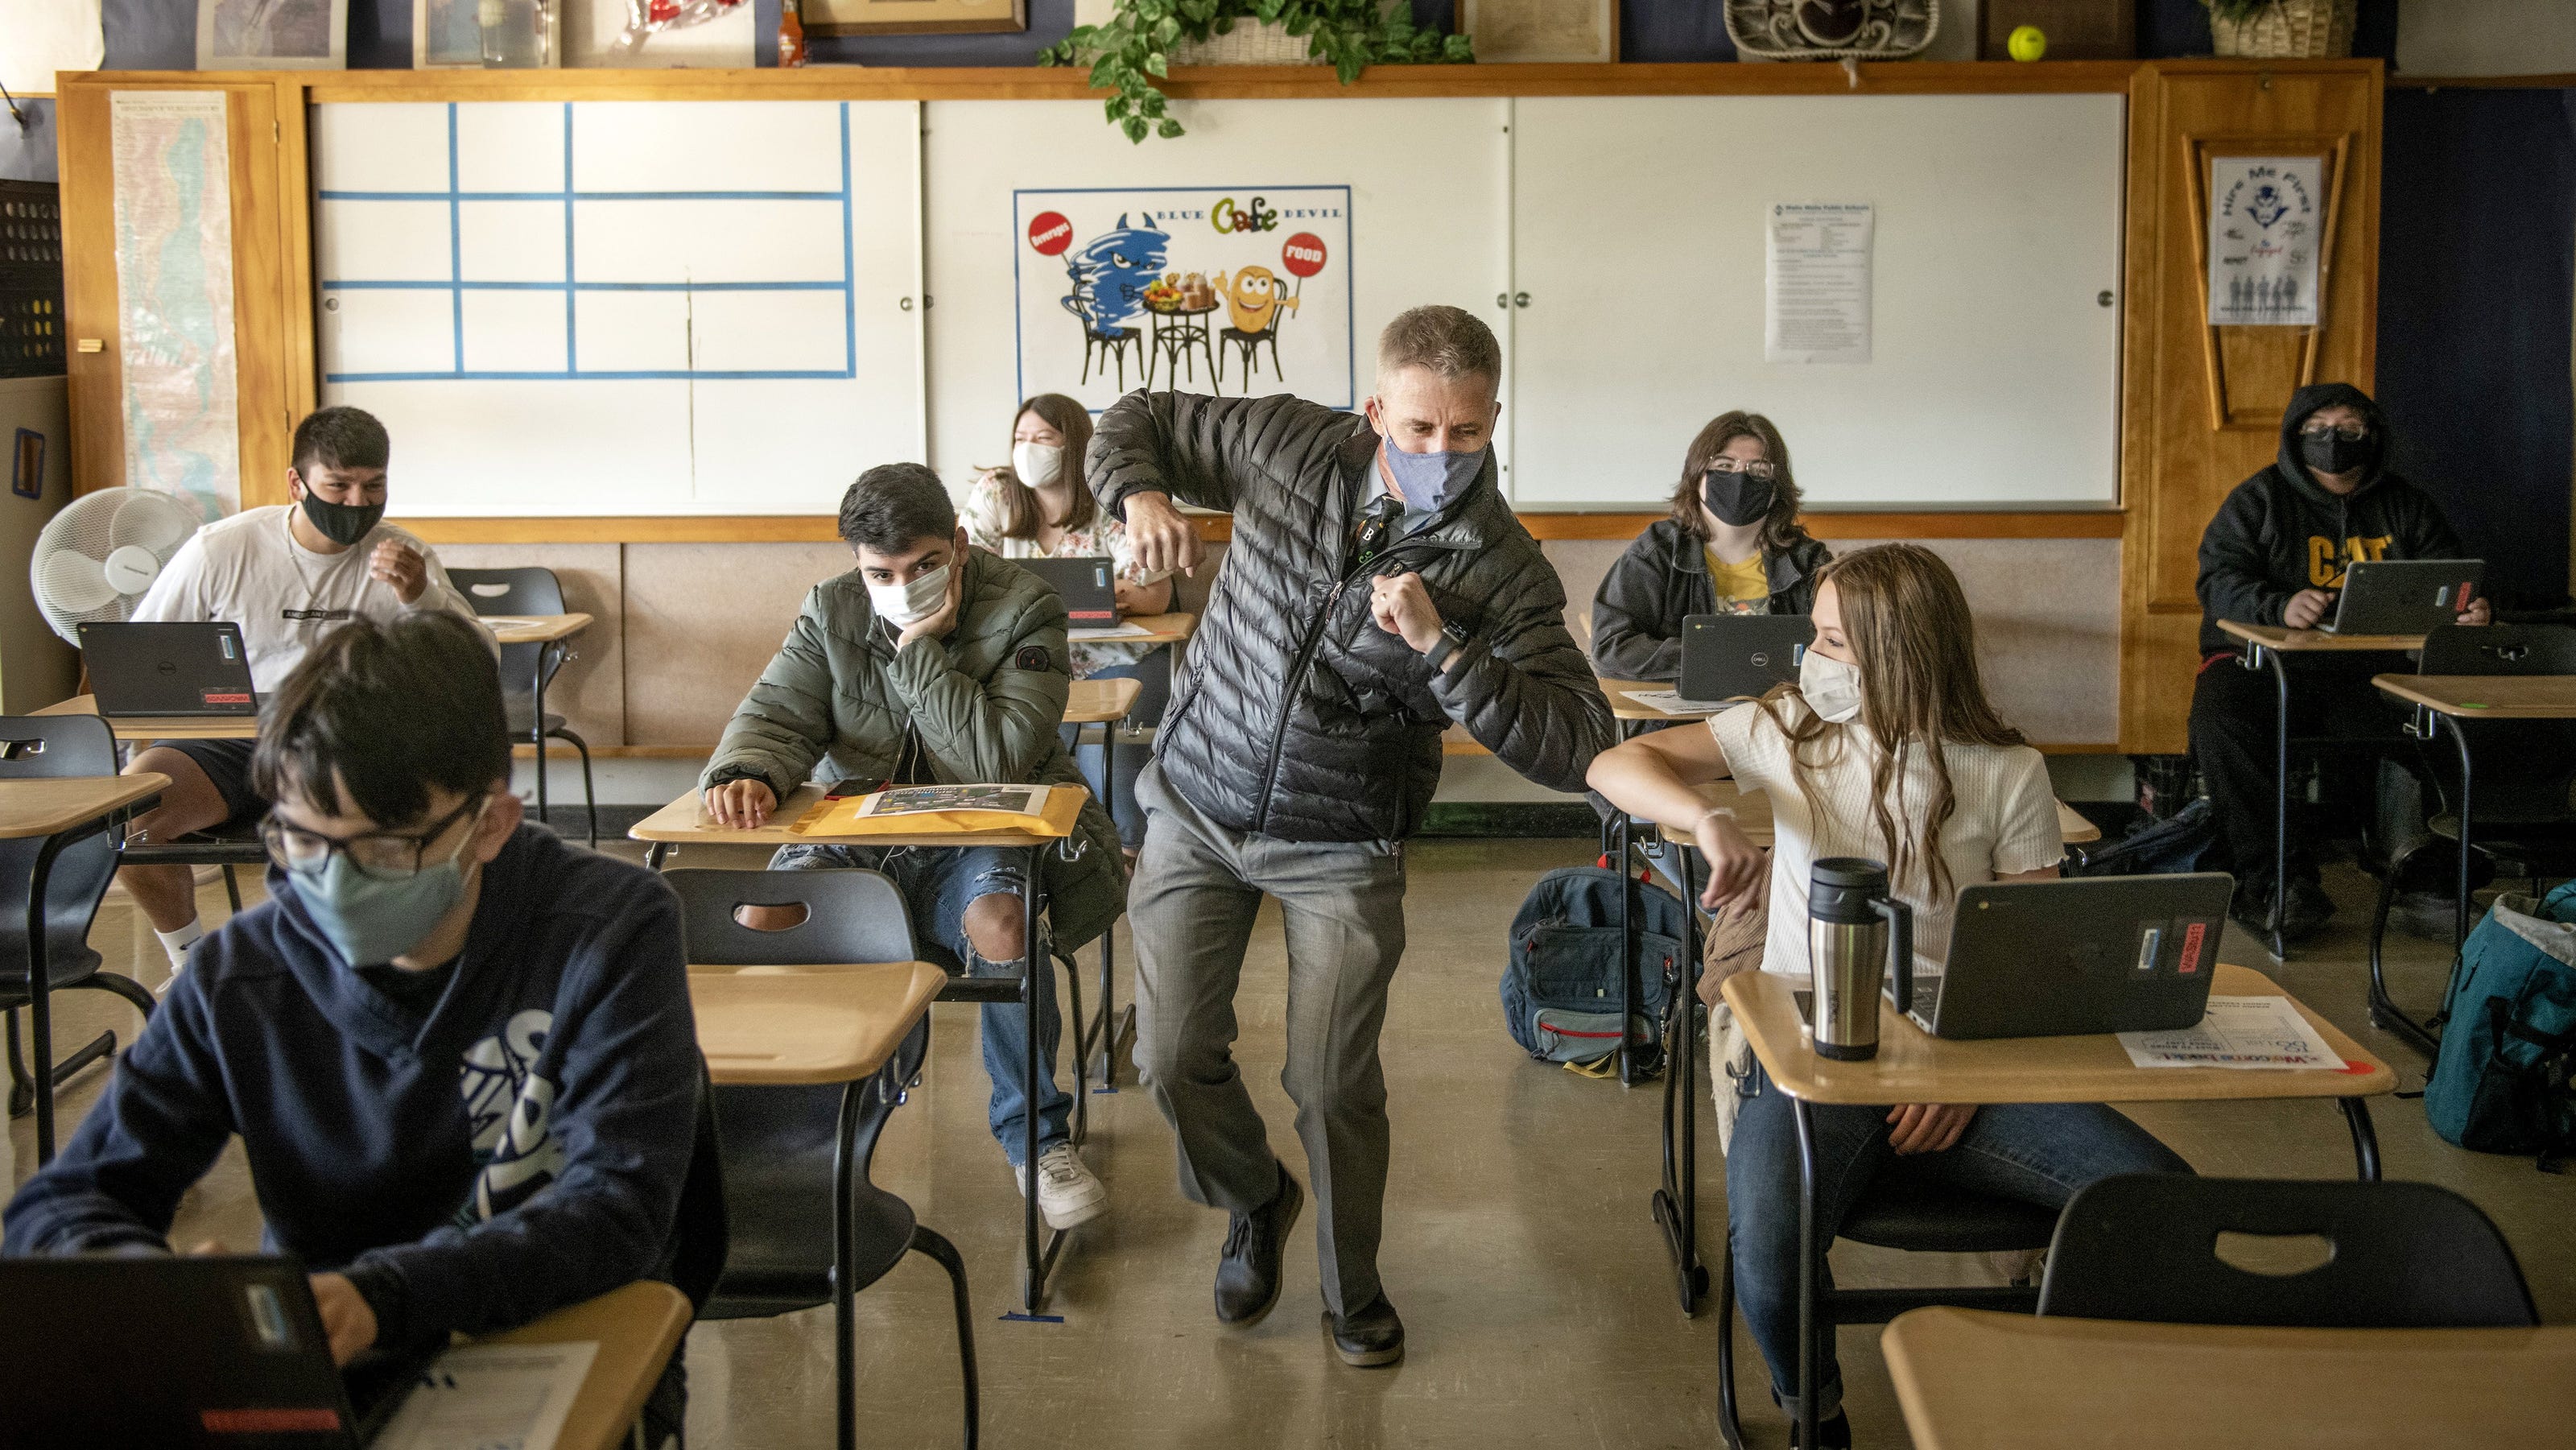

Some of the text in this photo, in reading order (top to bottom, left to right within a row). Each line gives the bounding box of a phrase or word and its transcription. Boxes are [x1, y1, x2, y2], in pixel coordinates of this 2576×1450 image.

[2223, 179, 2244, 216] Hire
[2283, 171, 2311, 213] First
[1157, 196, 1343, 234] BLUE Cafe DEVIL
[1030, 221, 1071, 247] Beverages
[1286, 245, 1323, 263] FOOD
[1362, 527, 1375, 541] B
[2308, 535, 2392, 589] CAT
